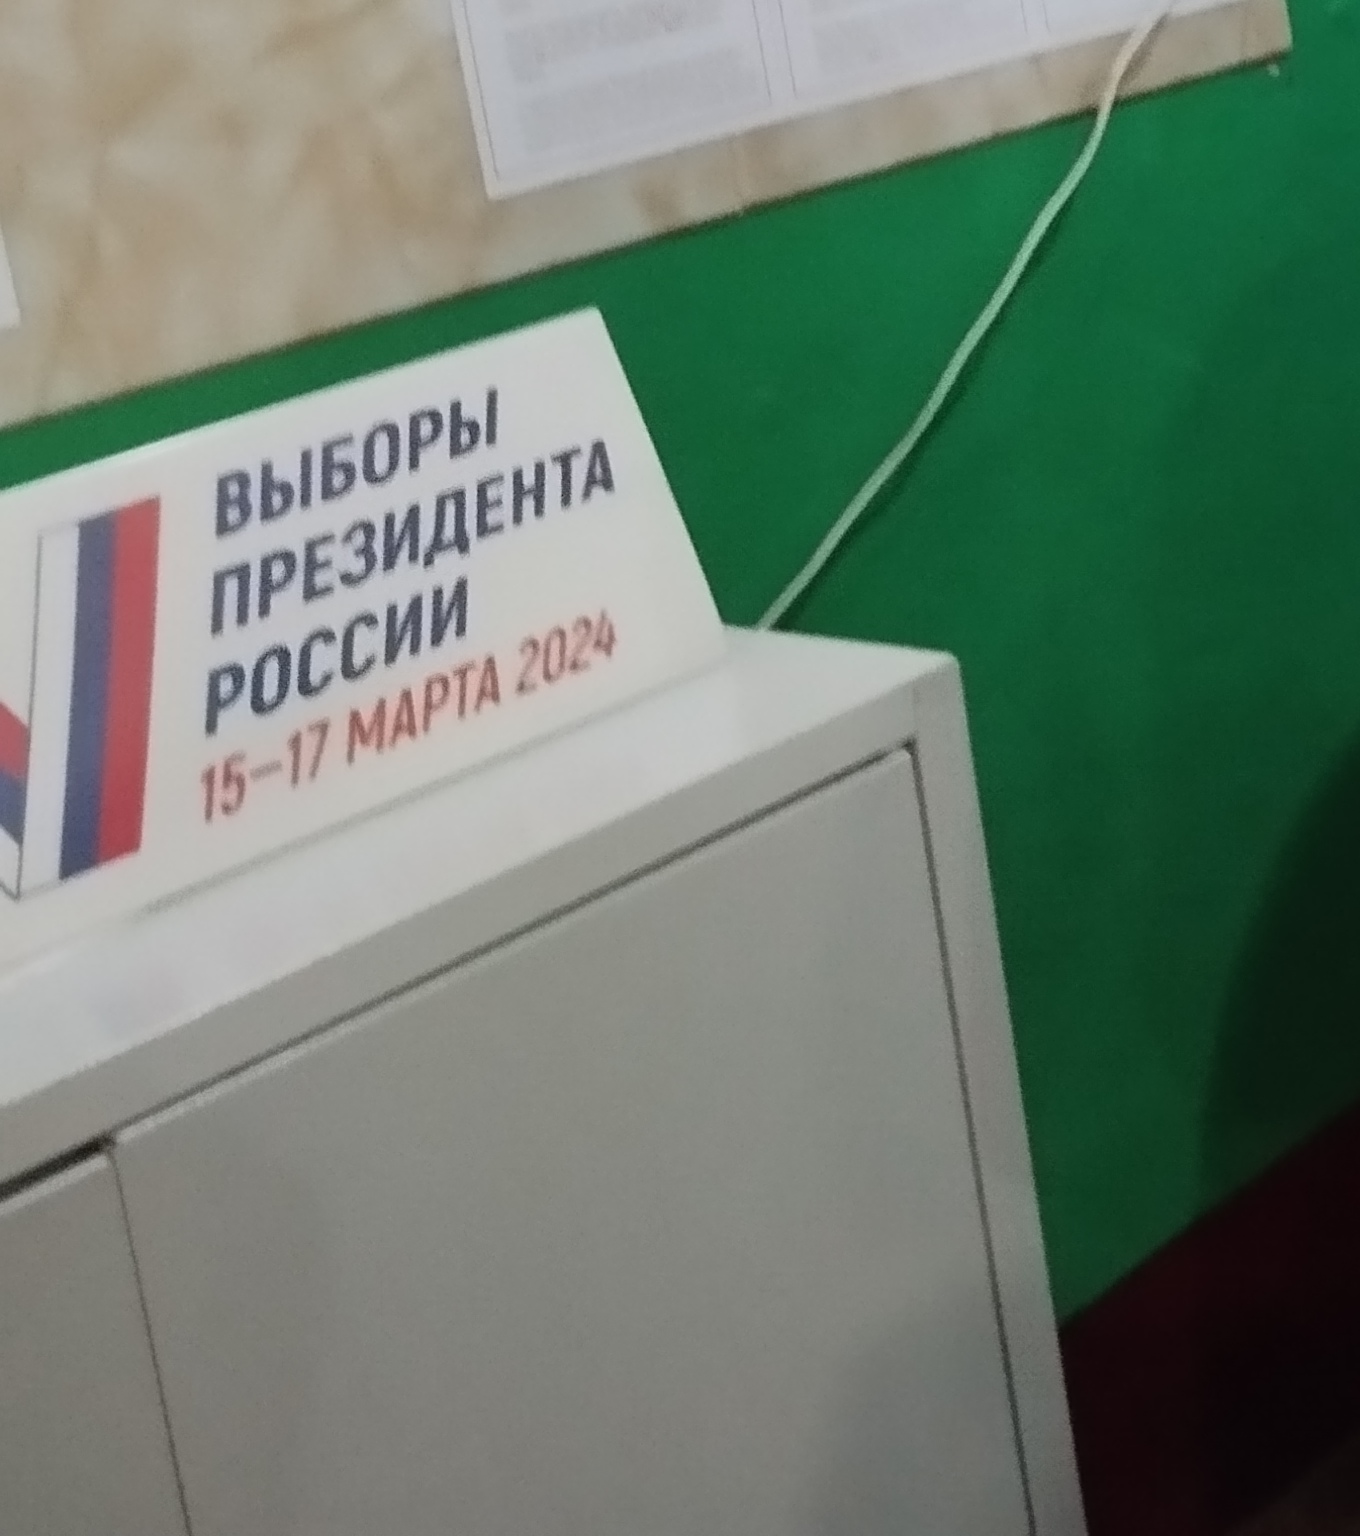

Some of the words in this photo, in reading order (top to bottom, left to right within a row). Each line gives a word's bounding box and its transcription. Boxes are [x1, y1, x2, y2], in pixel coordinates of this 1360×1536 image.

[210, 440, 615, 635] ПРЕЗИДЕНТА
[215, 387, 499, 539] ВЫБОРЫ
[205, 577, 469, 736] РОССИИ
[346, 655, 502, 764] МАРТА
[515, 609, 619, 696] 2024
